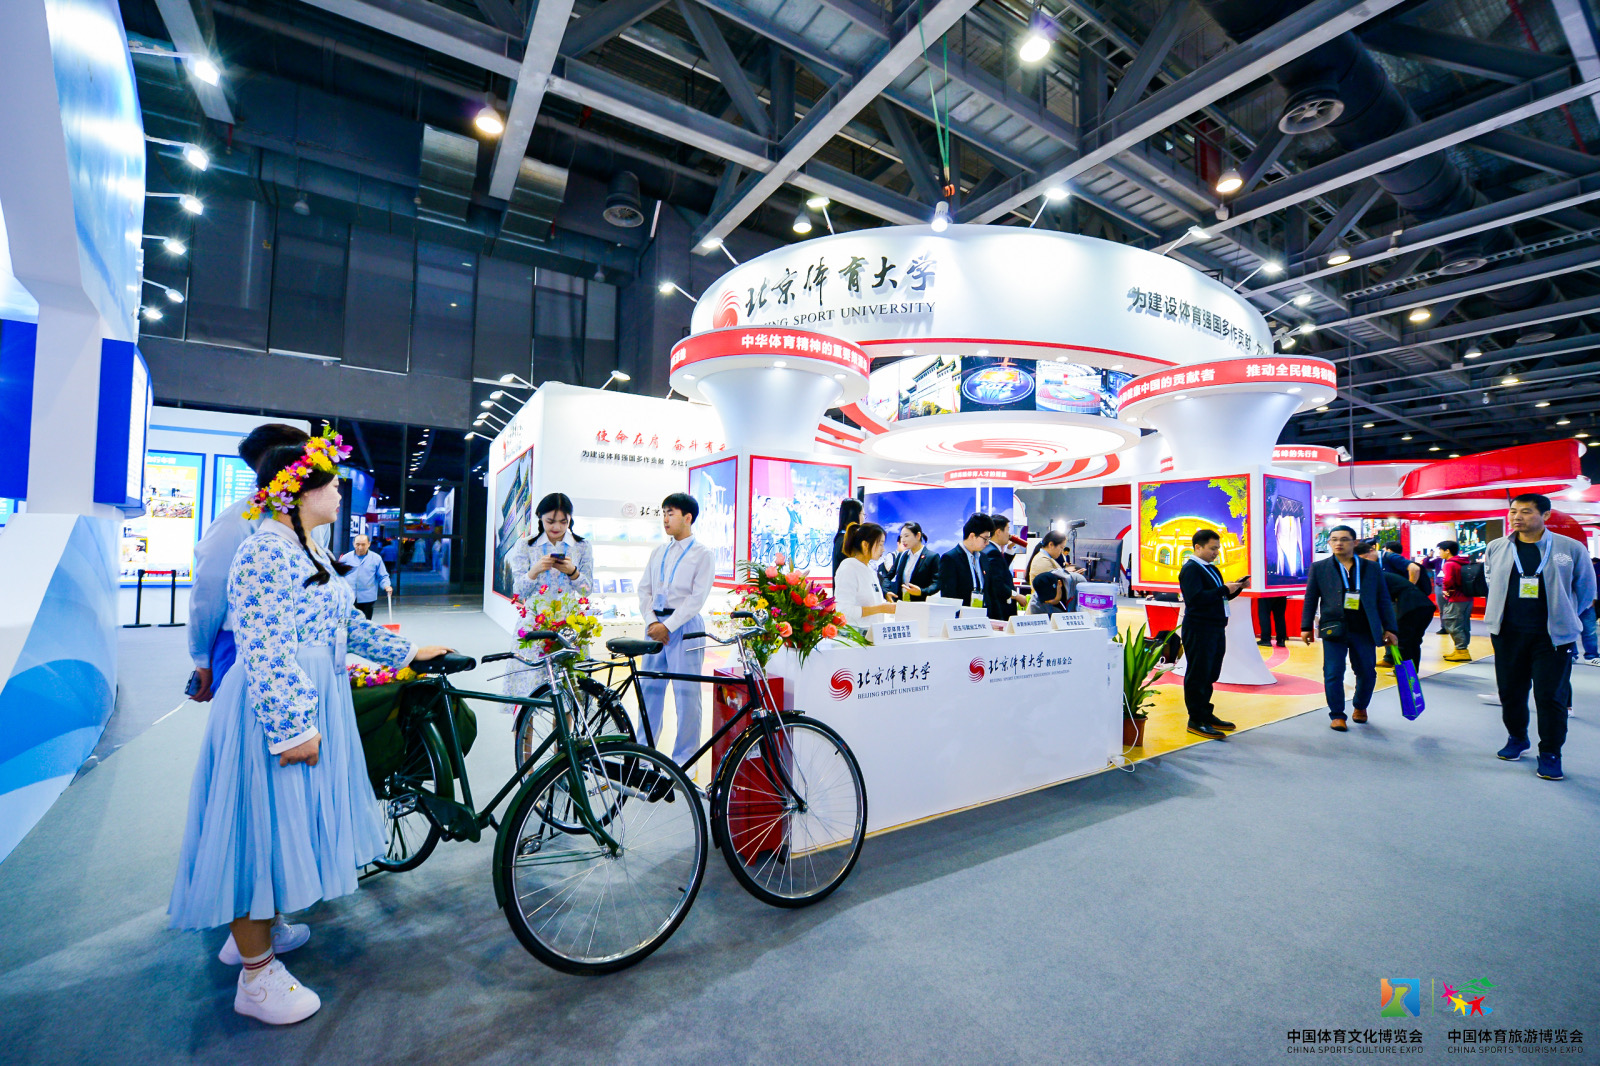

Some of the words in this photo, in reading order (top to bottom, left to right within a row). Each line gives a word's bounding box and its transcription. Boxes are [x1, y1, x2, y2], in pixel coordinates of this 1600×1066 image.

[745, 255, 936, 317] 北京体育大学
[794, 309, 835, 326] SPORT
[841, 302, 936, 319] UNIVERSITY
[1130, 287, 1252, 350] 为建设体育强国多作贡献
[596, 429, 659, 449] 使命在肩
[857, 661, 931, 689] 北京体育大学
[988, 652, 1044, 675] 北京体育大学
[857, 691, 880, 700] BEIJING
[881, 689, 897, 697] SPORT
[899, 685, 930, 694] UNIVERSITY
